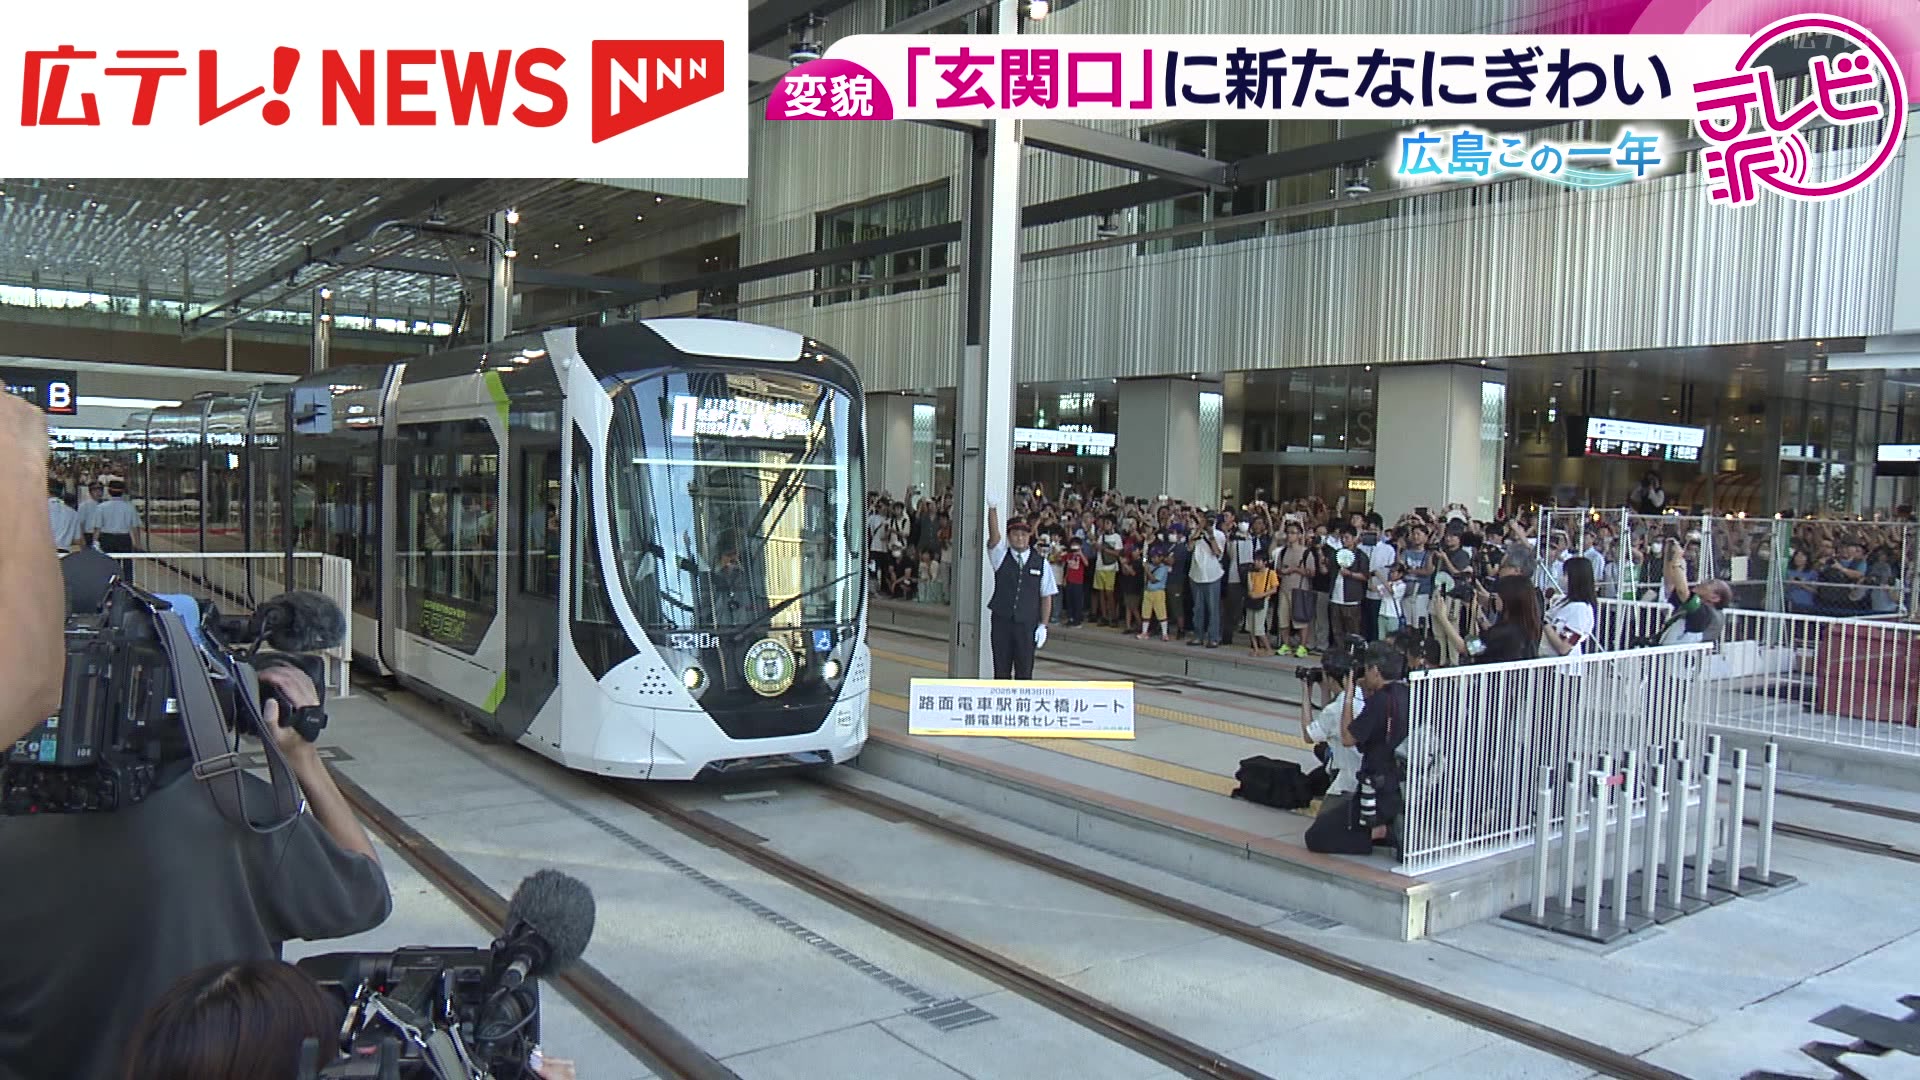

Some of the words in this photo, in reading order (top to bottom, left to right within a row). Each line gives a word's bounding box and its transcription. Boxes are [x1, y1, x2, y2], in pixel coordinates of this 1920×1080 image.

[49, 382, 72, 408] B
[919, 695, 1126, 714] 路面電車駅前大橋ルート
[950, 714, 1094, 727] 一番電車出発セレモニー
